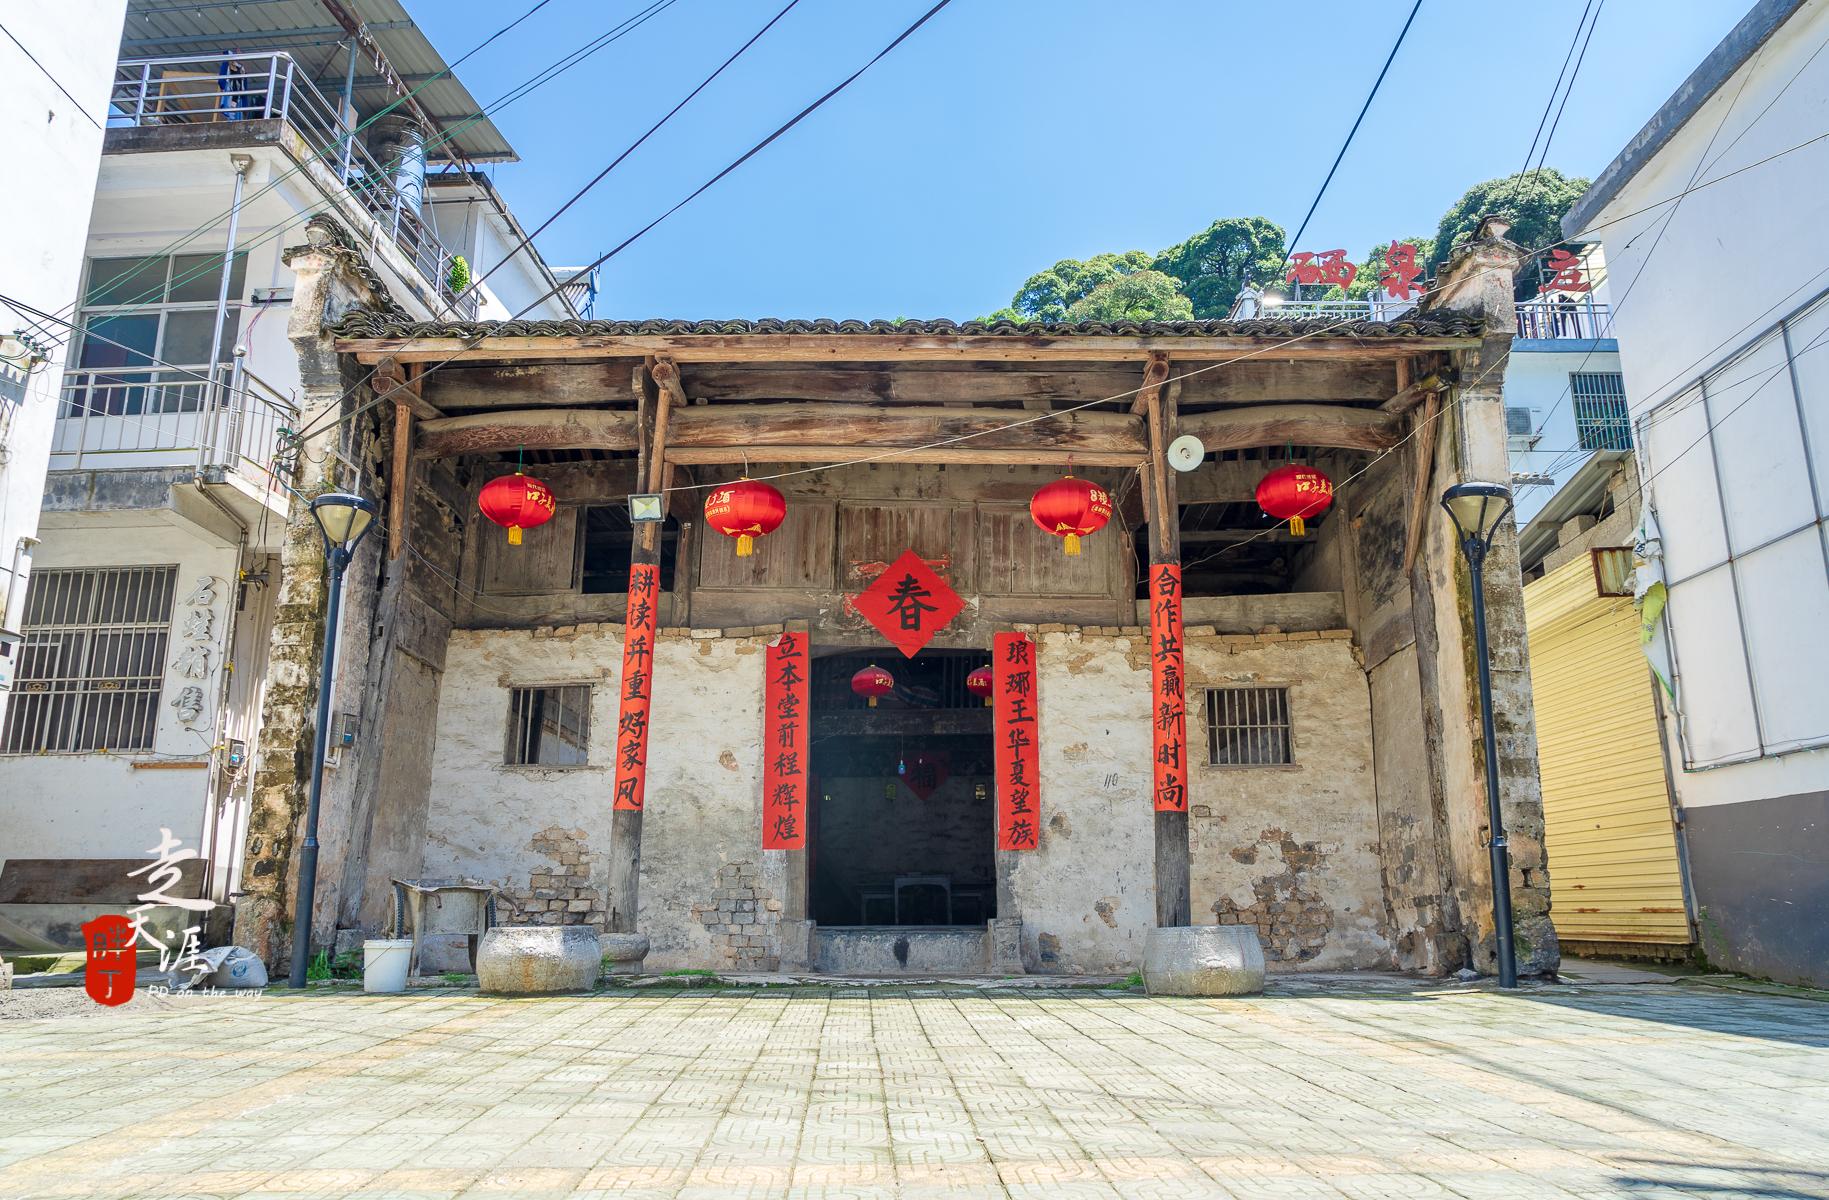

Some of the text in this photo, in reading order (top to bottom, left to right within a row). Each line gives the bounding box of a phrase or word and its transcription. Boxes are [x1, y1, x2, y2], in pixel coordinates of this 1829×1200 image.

[614, 569, 656, 807] 耕读并重好家风
[886, 573, 939, 631] 春
[1154, 566, 1184, 808] 合作共赢新时尚
[772, 634, 805, 842] 立本堂前程辉煌
[1005, 640, 1035, 846] 琅琊王华夏望族
